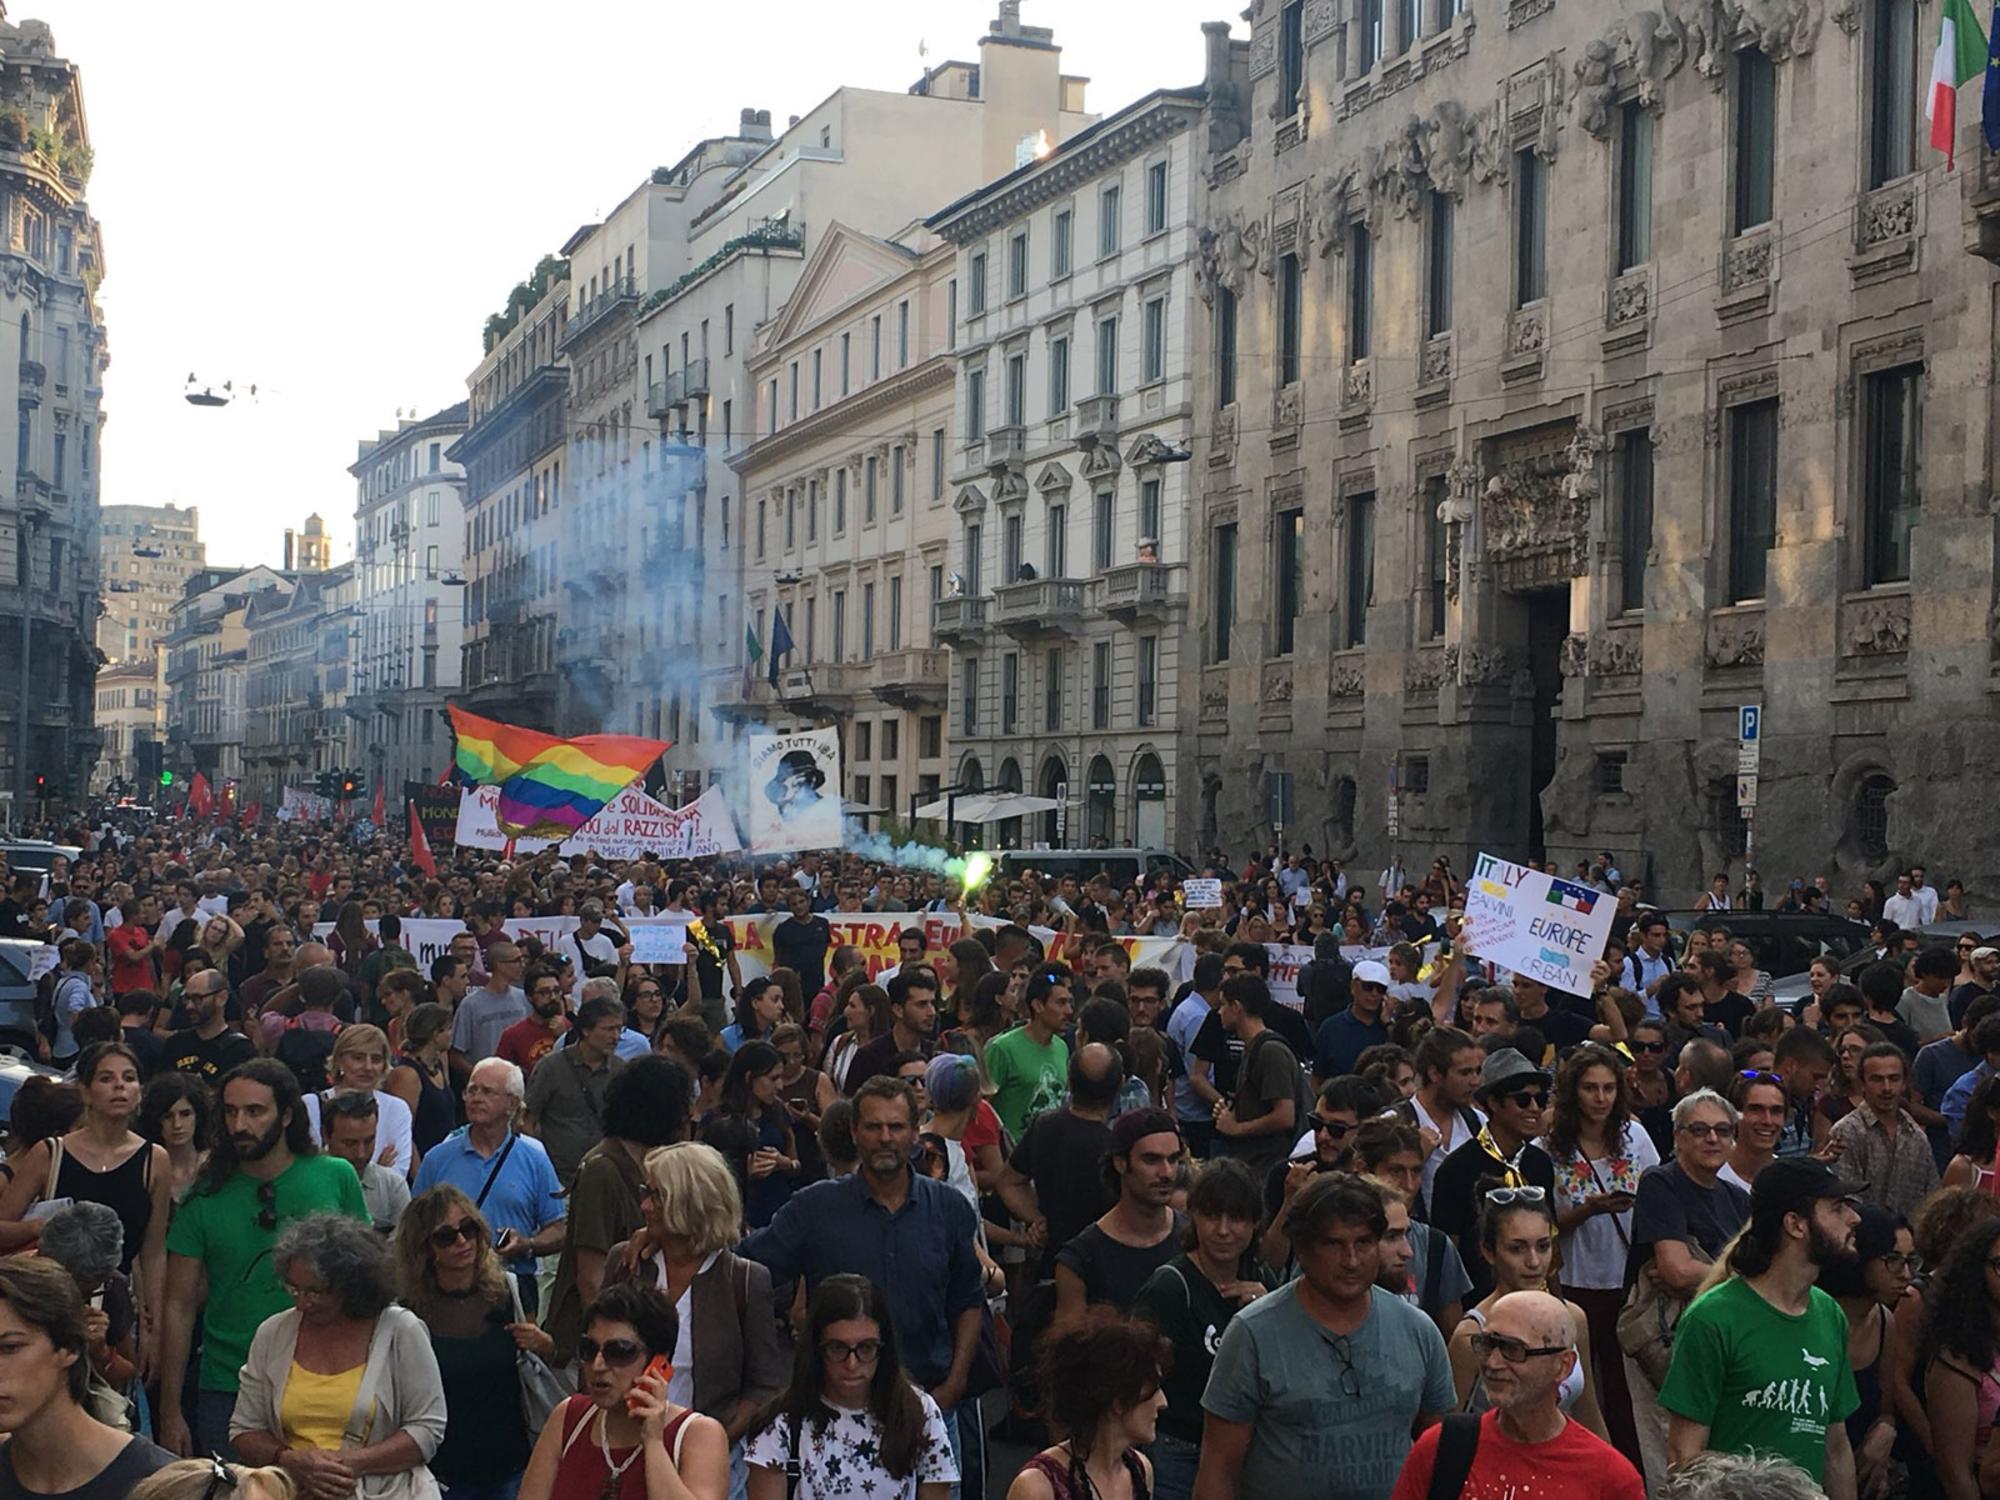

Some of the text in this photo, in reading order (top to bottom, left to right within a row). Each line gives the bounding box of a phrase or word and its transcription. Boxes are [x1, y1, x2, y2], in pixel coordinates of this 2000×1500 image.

[1745, 711, 1755, 736] P
[785, 738, 817, 748] TUTTI
[1529, 917, 1592, 955] EUROPE
